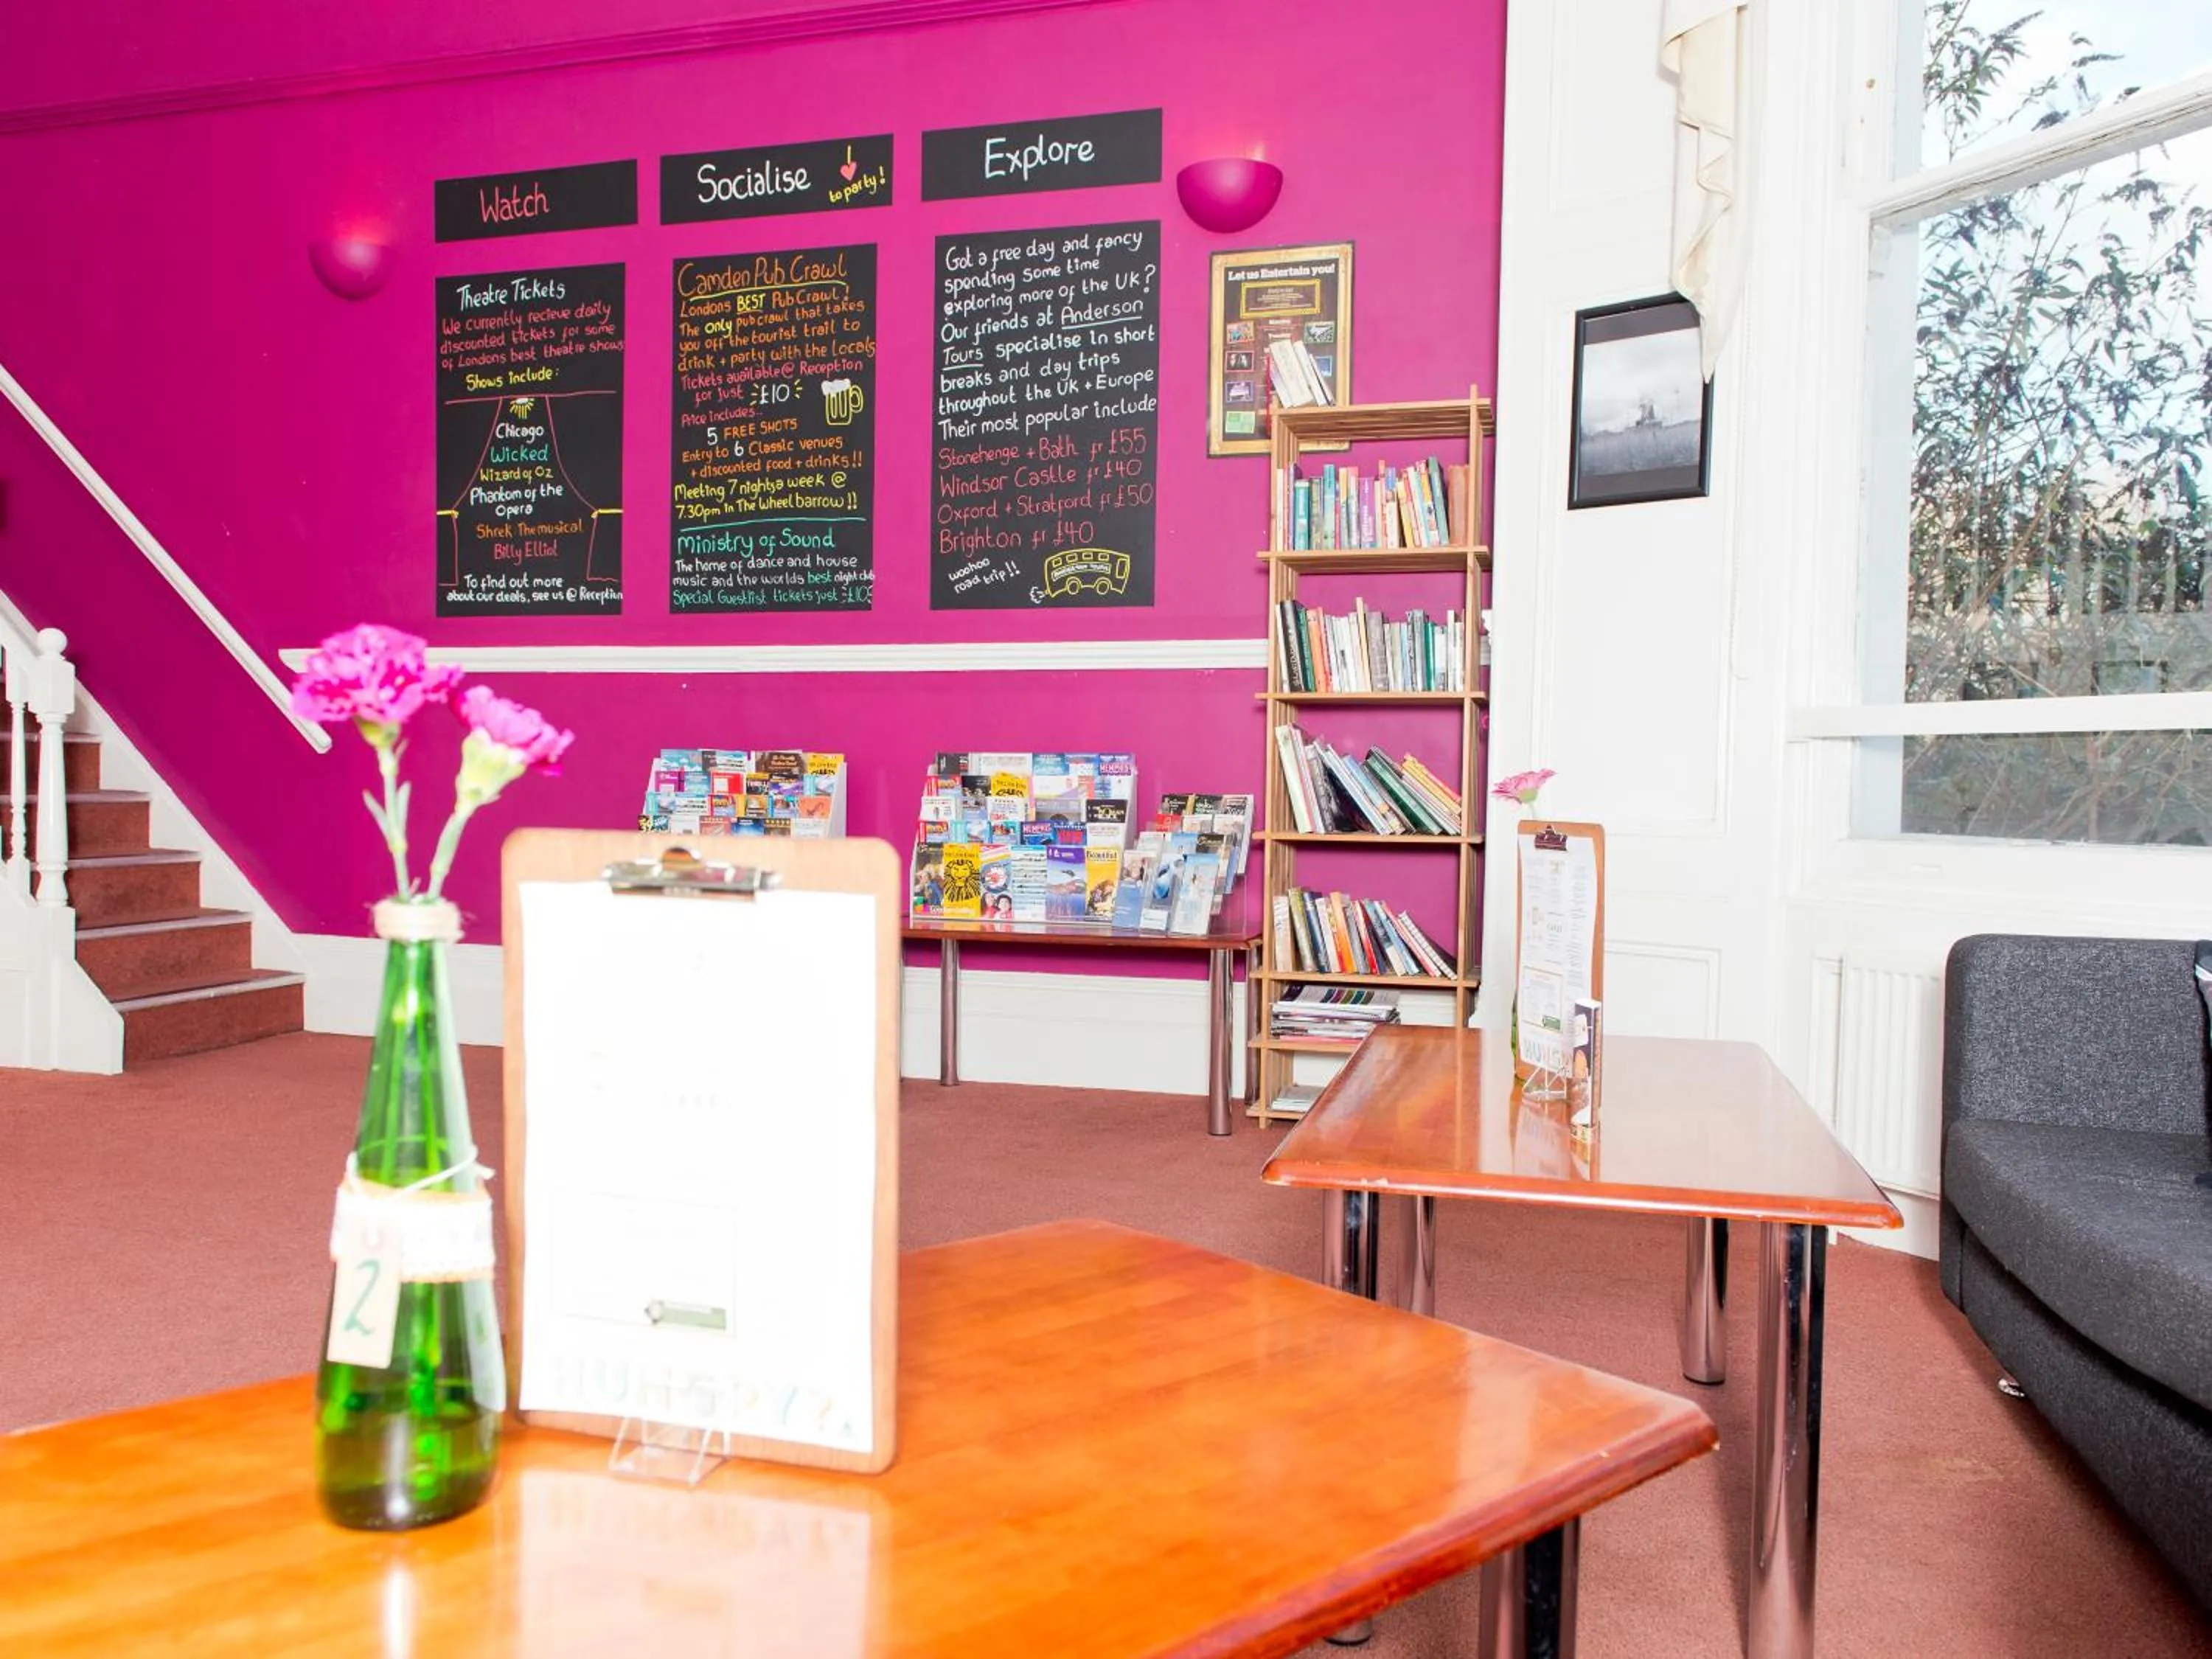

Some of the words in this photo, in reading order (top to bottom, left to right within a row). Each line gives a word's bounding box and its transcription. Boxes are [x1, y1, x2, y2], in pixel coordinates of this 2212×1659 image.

[983, 136, 1096, 180] Explore
[697, 164, 813, 204] Socialise
[479, 181, 549, 224] Watch
[945, 246, 973, 271] Got
[979, 253, 987, 262] a
[991, 246, 1020, 271] free
[1026, 240, 1055, 262] day
[1062, 234, 1090, 252] and
[1096, 232, 1143, 256] fancy
[678, 262, 749, 296] Camden
[754, 257, 785, 288] Pub
[790, 254, 847, 283] Crawl
[945, 271, 1015, 299] spending
[1068, 259, 1099, 274] time
[456, 284, 507, 310] Theatre
[512, 277, 566, 301] Tickets
[680, 299, 731, 317] Londons
[737, 293, 766, 312] BEST
[773, 291, 793, 308] Pub
[796, 288, 838, 304] Crawl
[944, 294, 1013, 316] exploring
[1019, 289, 1054, 303] more
[1082, 279, 1107, 294] the
[442, 319, 461, 335] We
[465, 310, 521, 331] currently
[529, 307, 571, 323] recieve
[575, 301, 611, 324] daily
[679, 324, 700, 336] The
[796, 307, 820, 321] that
[826, 298, 865, 314] takes
[942, 322, 970, 343] Our
[974, 313, 1029, 345] friends
[1036, 306, 1054, 324] at
[1062, 300, 1144, 322] Anderson
[441, 334, 506, 355] discounted
[679, 341, 700, 357] you
[729, 335, 748, 347] the
[751, 327, 796, 344] tourist
[804, 321, 835, 336] trail
[944, 346, 983, 365] Tours
[996, 333, 1081, 361] specialise
[1115, 324, 1155, 344] short
[459, 352, 507, 367] Londons
[511, 346, 536, 362] best
[678, 354, 714, 372] drink
[731, 350, 765, 368] party
[771, 345, 801, 361] with
[804, 342, 827, 357] the
[466, 374, 504, 391] Shows
[681, 373, 723, 391] Tickets
[726, 366, 780, 384] available
[800, 358, 863, 377] Reception
[941, 372, 992, 392] breaks
[999, 362, 1030, 382] and
[1040, 359, 1071, 380] day
[1079, 352, 1120, 372] trips
[759, 384, 789, 404] £10
[939, 385, 1017, 416] throughout
[1026, 384, 1051, 400] the
[1057, 378, 1079, 395] UK
[1096, 369, 1154, 390] Europe
[707, 428, 717, 445] 5
[724, 423, 755, 439] FREE
[761, 419, 798, 434] SHOTS
[939, 419, 976, 440] Their
[981, 414, 1019, 433] most
[1026, 405, 1088, 435] popular
[1095, 395, 1157, 418] include
[496, 423, 544, 443] Chicago
[490, 445, 548, 462] Wicked
[683, 451, 712, 464] Entry
[734, 441, 743, 456] 6
[939, 444, 1020, 469] Stonehenge
[1039, 434, 1079, 460] Bath
[1109, 428, 1146, 454] £55
[481, 469, 521, 481] Wizard
[535, 466, 553, 479] Oz
[700, 459, 761, 478] discounted
[766, 458, 792, 471] food
[940, 473, 1008, 498] Windsor
[1015, 465, 1077, 487] Castle
[1104, 460, 1141, 479] £40
[470, 487, 521, 505] Phantom
[540, 484, 563, 496] the
[728, 479, 737, 495] 7
[787, 473, 825, 487] week
[495, 504, 533, 518] Opera
[675, 505, 720, 522] 7.30pm
[737, 500, 756, 510] The
[938, 500, 998, 524] Oxford
[1017, 490, 1091, 518] Stratford
[1115, 484, 1153, 507] £50
[476, 524, 512, 539] Shrek
[780, 528, 835, 547] Sound
[939, 526, 1021, 557] Brighton
[1054, 521, 1094, 545] £40
[675, 560, 693, 574] The
[695, 557, 727, 571] home
[748, 556, 783, 568] dance
[787, 554, 811, 567] and
[816, 554, 857, 567] house
[464, 574, 478, 588] To
[481, 574, 505, 590] find
[509, 573, 529, 587] out
[533, 577, 563, 587] more
[672, 575, 708, 586] music
[712, 574, 733, 586] and
[737, 574, 758, 585] the
[808, 572, 832, 583] best
[955, 577, 981, 594] road
[447, 591, 474, 601] about
[580, 587, 623, 604] Reception
[673, 590, 712, 608] Special
[343, 1259, 381, 1337] 2
